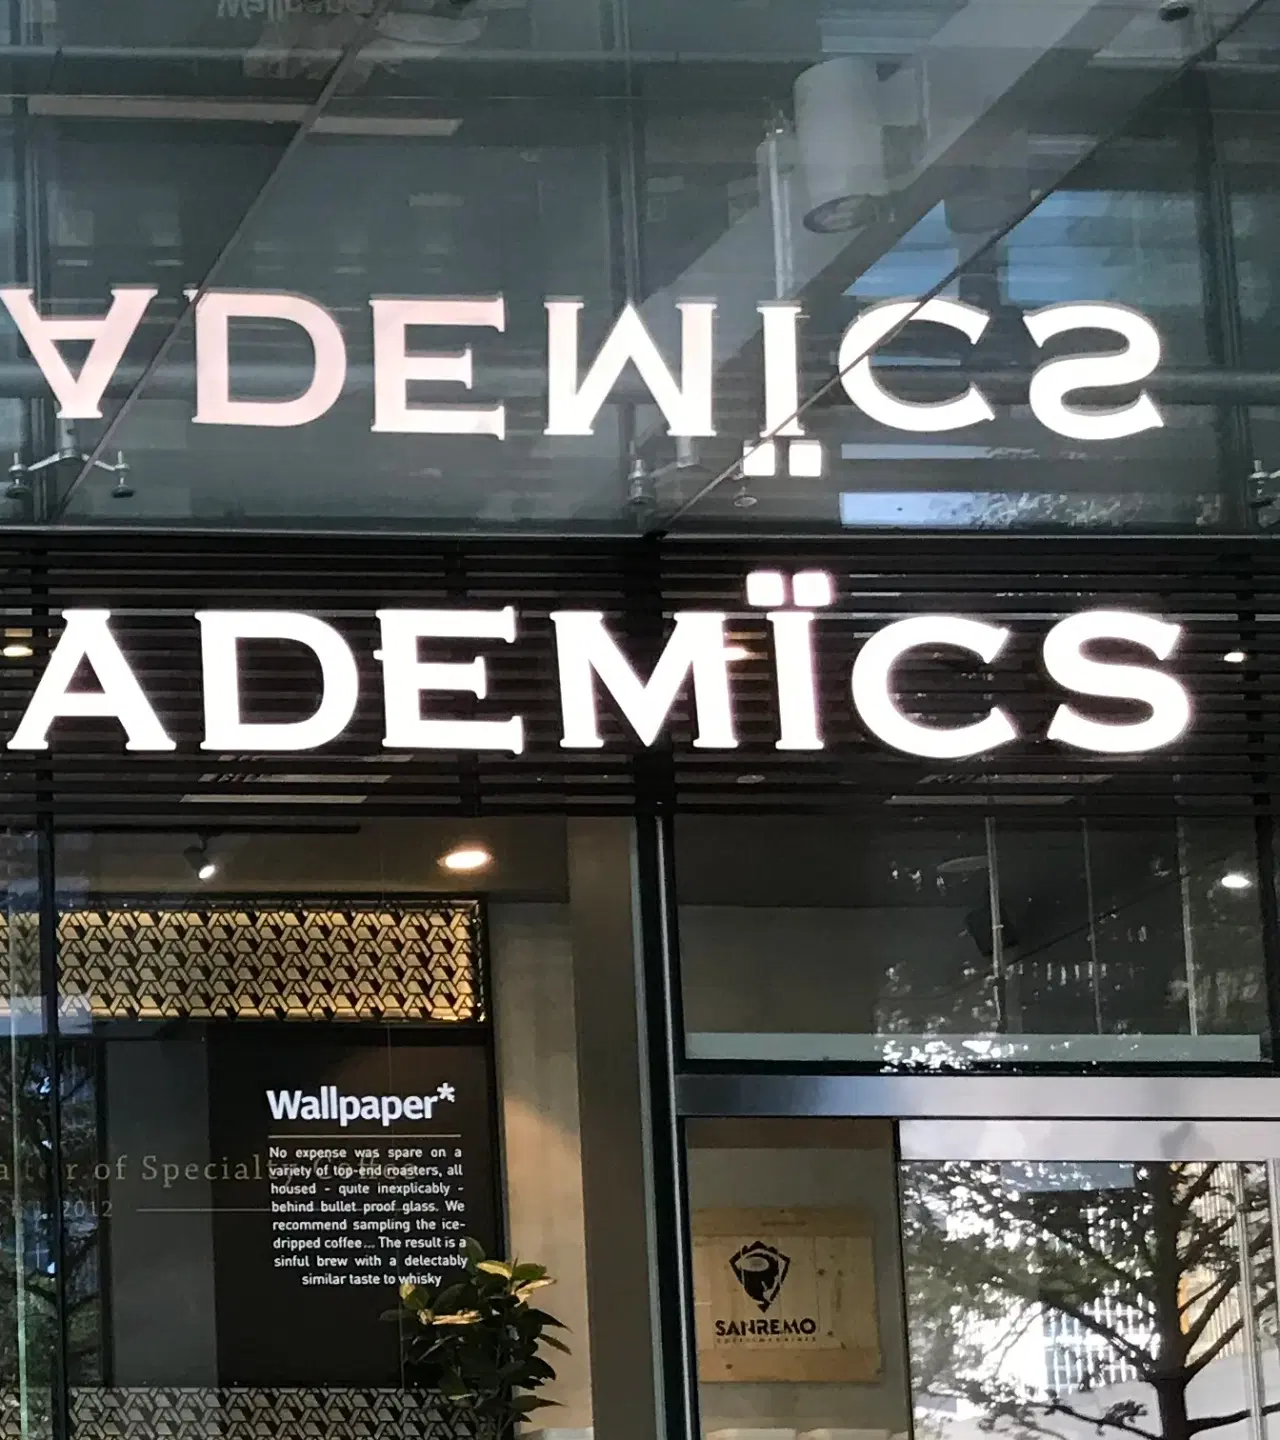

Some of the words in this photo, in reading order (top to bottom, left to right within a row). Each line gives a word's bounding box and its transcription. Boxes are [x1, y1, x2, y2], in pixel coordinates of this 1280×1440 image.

[269, 1147, 287, 1158] No
[295, 1148, 347, 1161] expense
[354, 1148, 380, 1158] was
[388, 1148, 422, 1161] spare
[431, 1148, 446, 1158] on
[454, 1148, 462, 1158] a
[269, 1165, 312, 1179] variety
[316, 1165, 328, 1176] of
[334, 1165, 382, 1179] top-end
[387, 1165, 442, 1177] roasters,
[447, 1164, 463, 1175] all
[271, 1183, 316, 1195] housed
[339, 1183, 370, 1196] quite
[378, 1183, 450, 1196] inexplicably
[272, 1200, 314, 1213] behind
[321, 1200, 356, 1212] bullet
[363, 1200, 396, 1215] proof
[402, 1200, 438, 1215] glass.
[445, 1201, 465, 1212] We
[272, 1219, 347, 1230] recommend
[353, 1219, 410, 1233] sampling
[416, 1219, 436, 1230] the
[273, 1237, 321, 1251] dripped
[378, 1236, 401, 1248] The
[405, 1236, 441, 1248] result
[445, 1236, 456, 1248] is
[459, 1238, 466, 1248] a
[274, 1255, 310, 1267] sinful
[317, 1255, 348, 1267] brew
[355, 1255, 382, 1267] with
[389, 1258, 396, 1267] a
[405, 1254, 468, 1269] delectably
[302, 1273, 347, 1285] similar
[349, 1273, 380, 1285] taste
[384, 1273, 396, 1285] to
[399, 1273, 441, 1287] whisky
[715, 1318, 816, 1336] SANREMO
